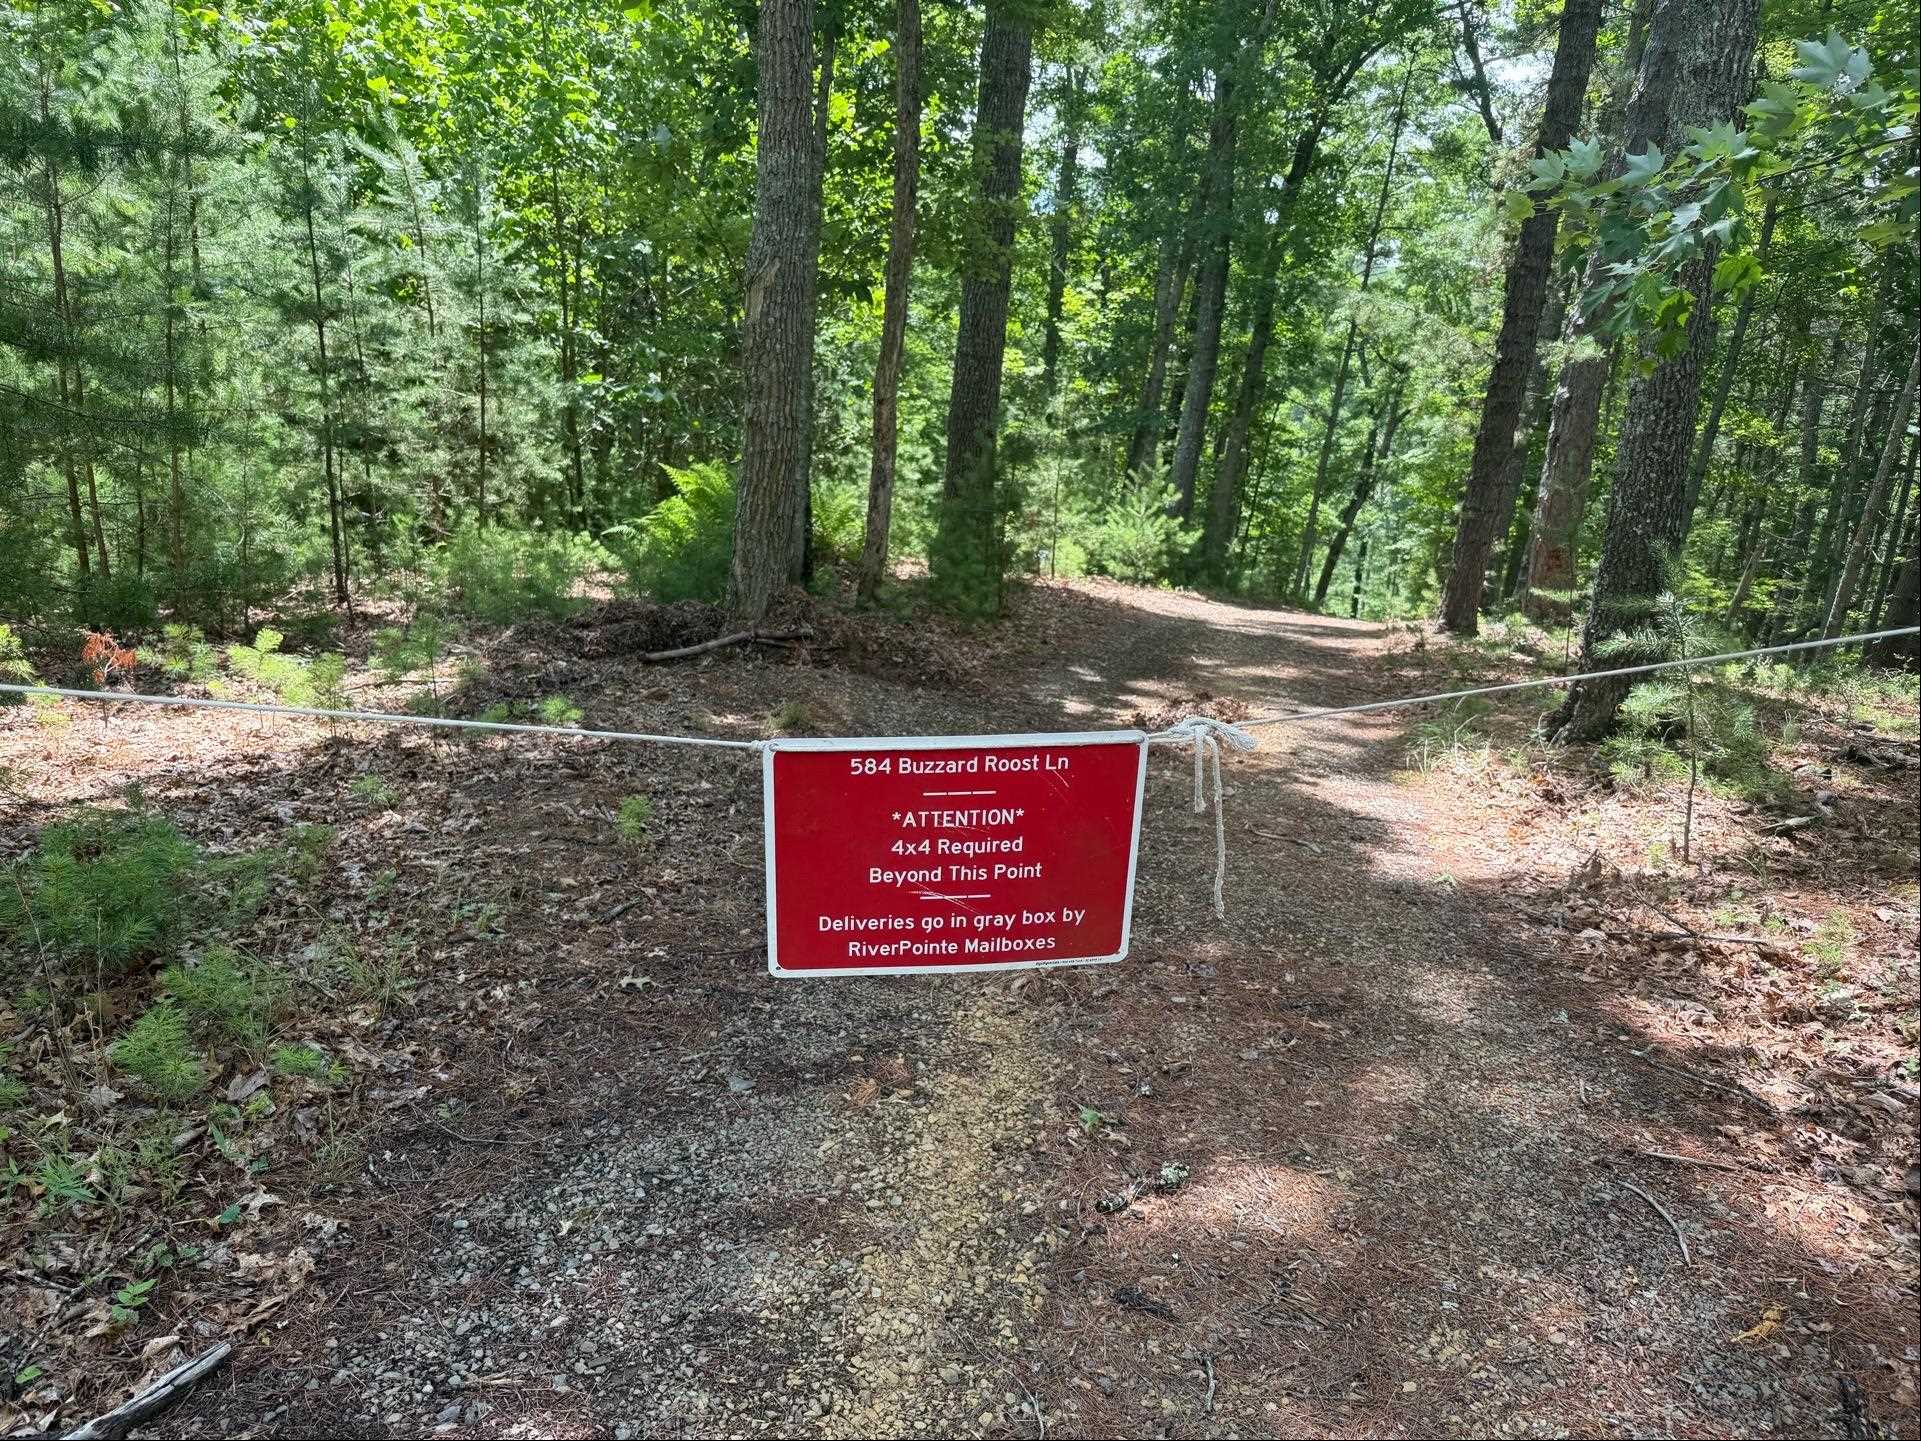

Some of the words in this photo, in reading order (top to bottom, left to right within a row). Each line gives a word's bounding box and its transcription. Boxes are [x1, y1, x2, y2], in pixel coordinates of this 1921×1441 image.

[850, 757, 892, 776] 584
[898, 754, 978, 774] Buzzard
[984, 753, 1041, 772] Roost
[1045, 749, 1070, 771] Ln
[891, 839, 931, 856] 4x4
[937, 836, 1024, 859] Required
[869, 866, 942, 888] Beyond
[949, 864, 988, 882] This
[994, 862, 1043, 881] Point
[819, 914, 915, 932] Deliveries
[921, 917, 944, 934] go
[950, 913, 967, 929] in
[973, 914, 1017, 933] gray
[1022, 909, 1056, 926] box
[1062, 907, 1086, 926] by
[848, 939, 959, 957] RiverPointe
[964, 935, 1057, 955] Mailboxes
